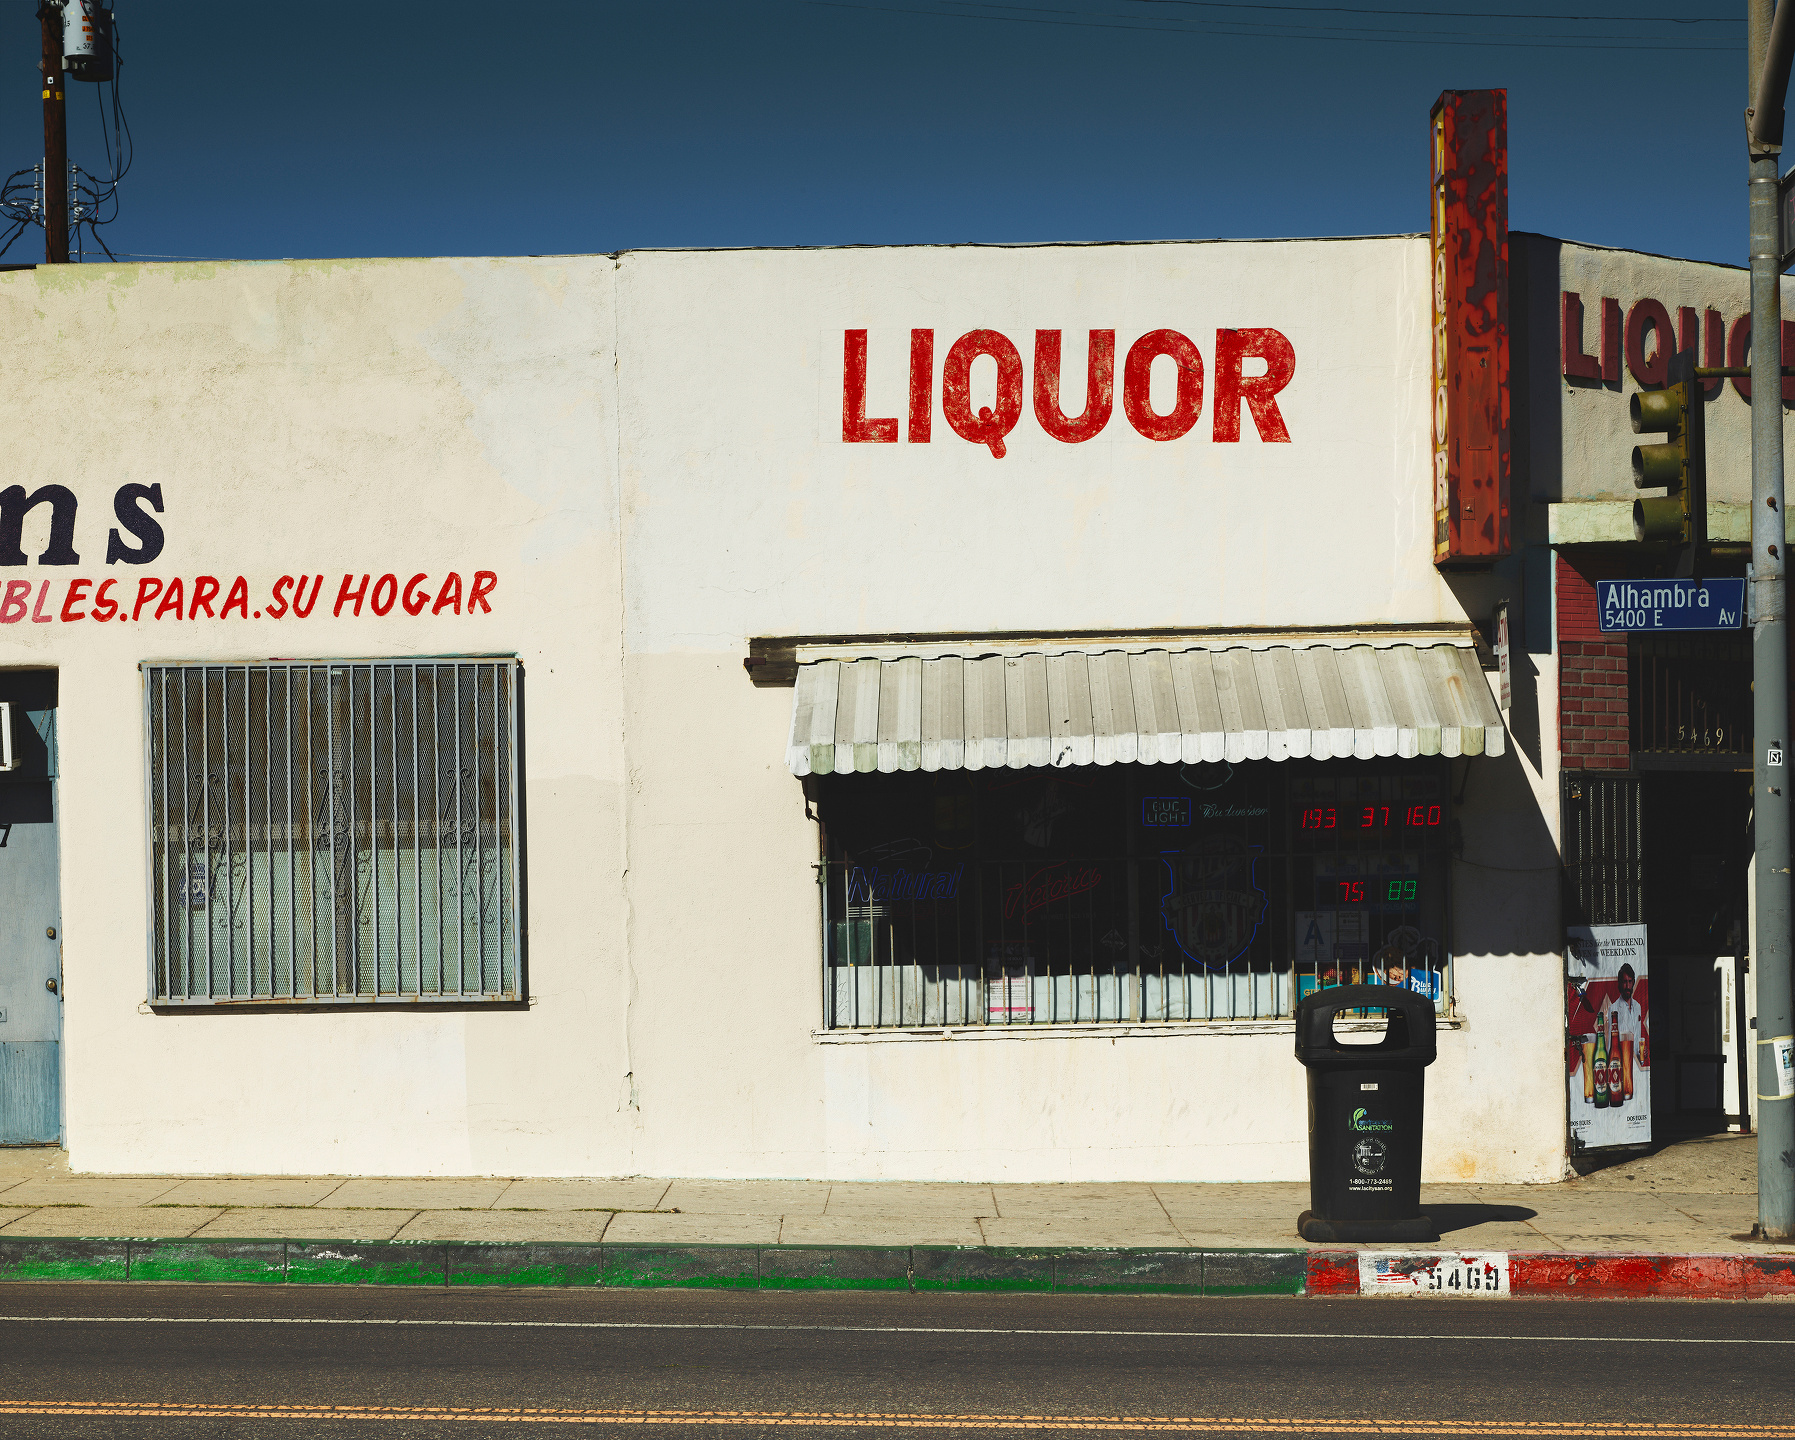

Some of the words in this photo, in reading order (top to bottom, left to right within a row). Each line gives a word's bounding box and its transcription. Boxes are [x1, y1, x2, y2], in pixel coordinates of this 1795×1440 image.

[1434, 121, 1449, 513] LIQUOR
[843, 328, 1296, 459] LIQUOR
[332, 571, 498, 618] HOGAR
[1606, 584, 1710, 608] Alhambra
[1606, 610, 1646, 628] 5400
[1654, 610, 1663, 626] E
[1718, 608, 1735, 625] Av
[1677, 726, 1723, 747] 5469
[1147, 812, 1188, 823] LIGHT
[1199, 803, 1269, 818] Budweiser
[1361, 806, 1390, 828] 37
[1406, 805, 1441, 826] 160
[847, 862, 964, 904] Natural
[1004, 857, 1103, 925] Victoria
[1339, 881, 1365, 902] 75
[1387, 880, 1417, 900] 89
[1303, 920, 1325, 945] A
[1611, 938, 1644, 946] WEEKEND,
[1600, 948, 1637, 957] WEEKDAYS.
[1428, 1267, 1499, 1290] 5469
